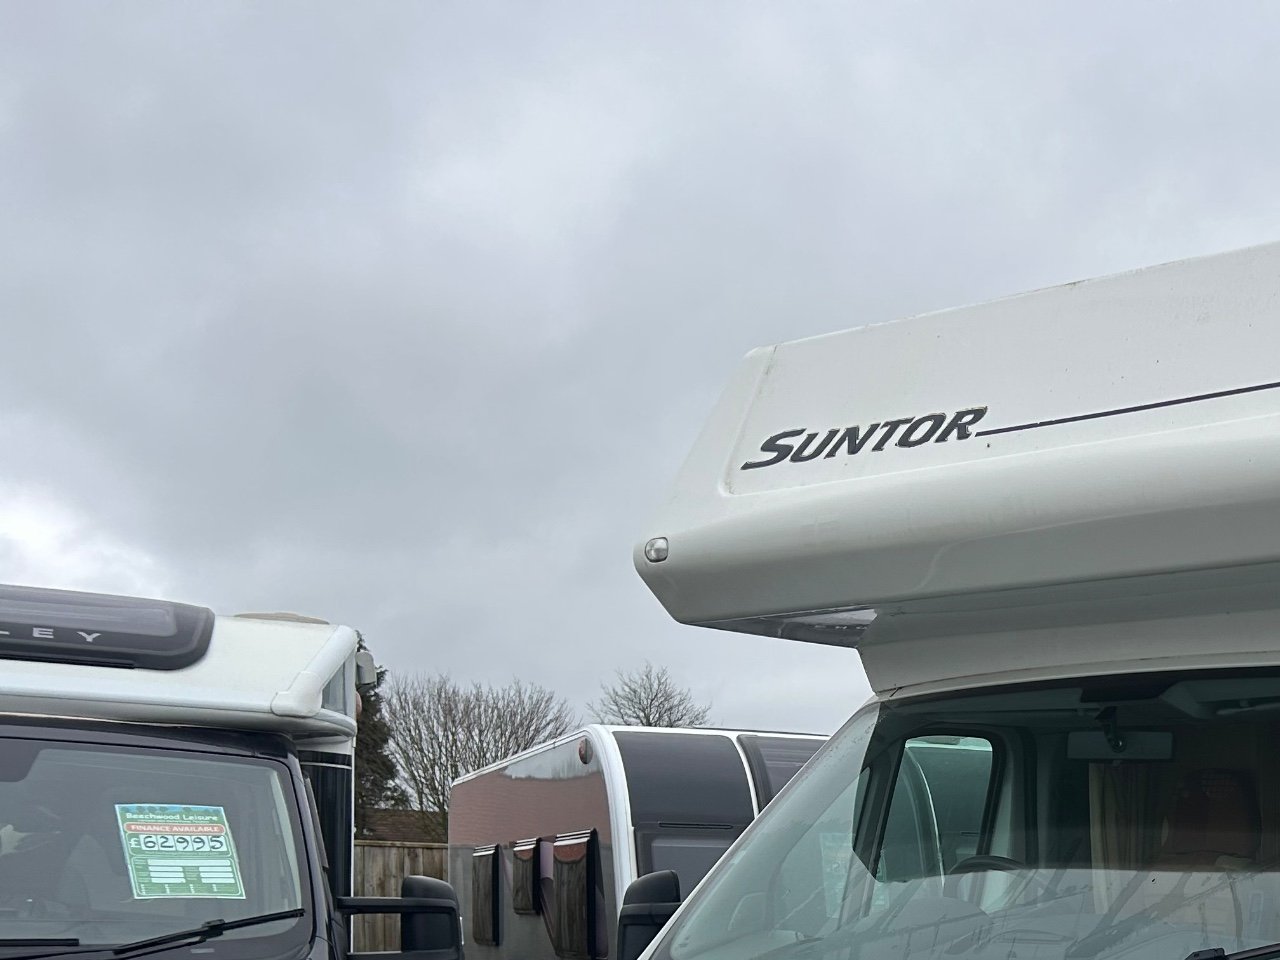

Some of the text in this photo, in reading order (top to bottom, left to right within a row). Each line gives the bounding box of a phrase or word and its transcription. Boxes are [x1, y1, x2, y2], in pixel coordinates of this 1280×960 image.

[740, 405, 988, 470] SUNTOR
[0, 627, 101, 642] EY
[126, 812, 180, 821] Beechwood
[183, 814, 219, 822] Leisure
[131, 824, 220, 833] FINANCE AVAILABLE
